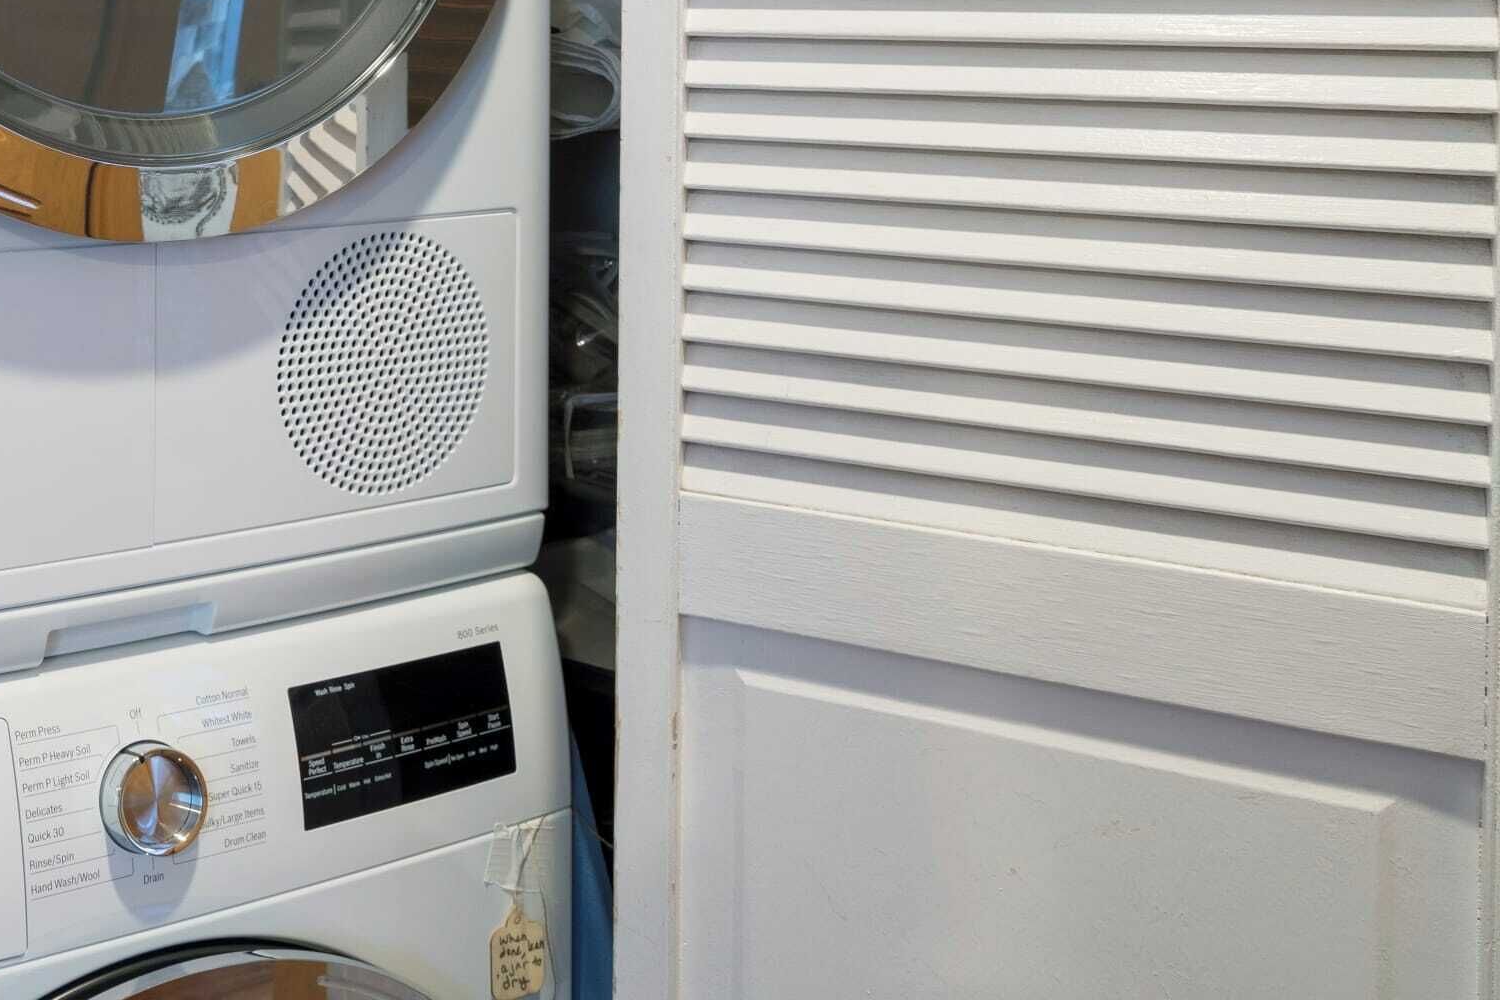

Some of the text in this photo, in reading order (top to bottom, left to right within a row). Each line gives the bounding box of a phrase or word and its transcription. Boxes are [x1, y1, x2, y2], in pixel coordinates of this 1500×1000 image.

[456, 624, 499, 640] 800 Series
[196, 688, 248, 706] Cotton Normal
[129, 708, 142, 720] Off
[202, 710, 252, 729] Whitest White
[14, 724, 60, 741] Perm Press
[231, 736, 256, 748] Towels
[19, 744, 91, 768] Perm P Heavy Soil
[334, 756, 364, 770] Temperature
[230, 760, 259, 774] Sanitize
[22, 771, 90, 794] Perm P Light Soil
[208, 789, 231, 802] Super
[232, 784, 252, 798] Quick
[25, 804, 62, 820] Delicates
[244, 808, 265, 819] Items
[28, 827, 64, 844] Quick 30
[224, 831, 266, 848] Drum Clean
[30, 852, 75, 871] Rinse/Spin
[30, 869, 100, 895] Hand Wash/Wool
[143, 872, 164, 886] Drain
[502, 975, 530, 990] dry
